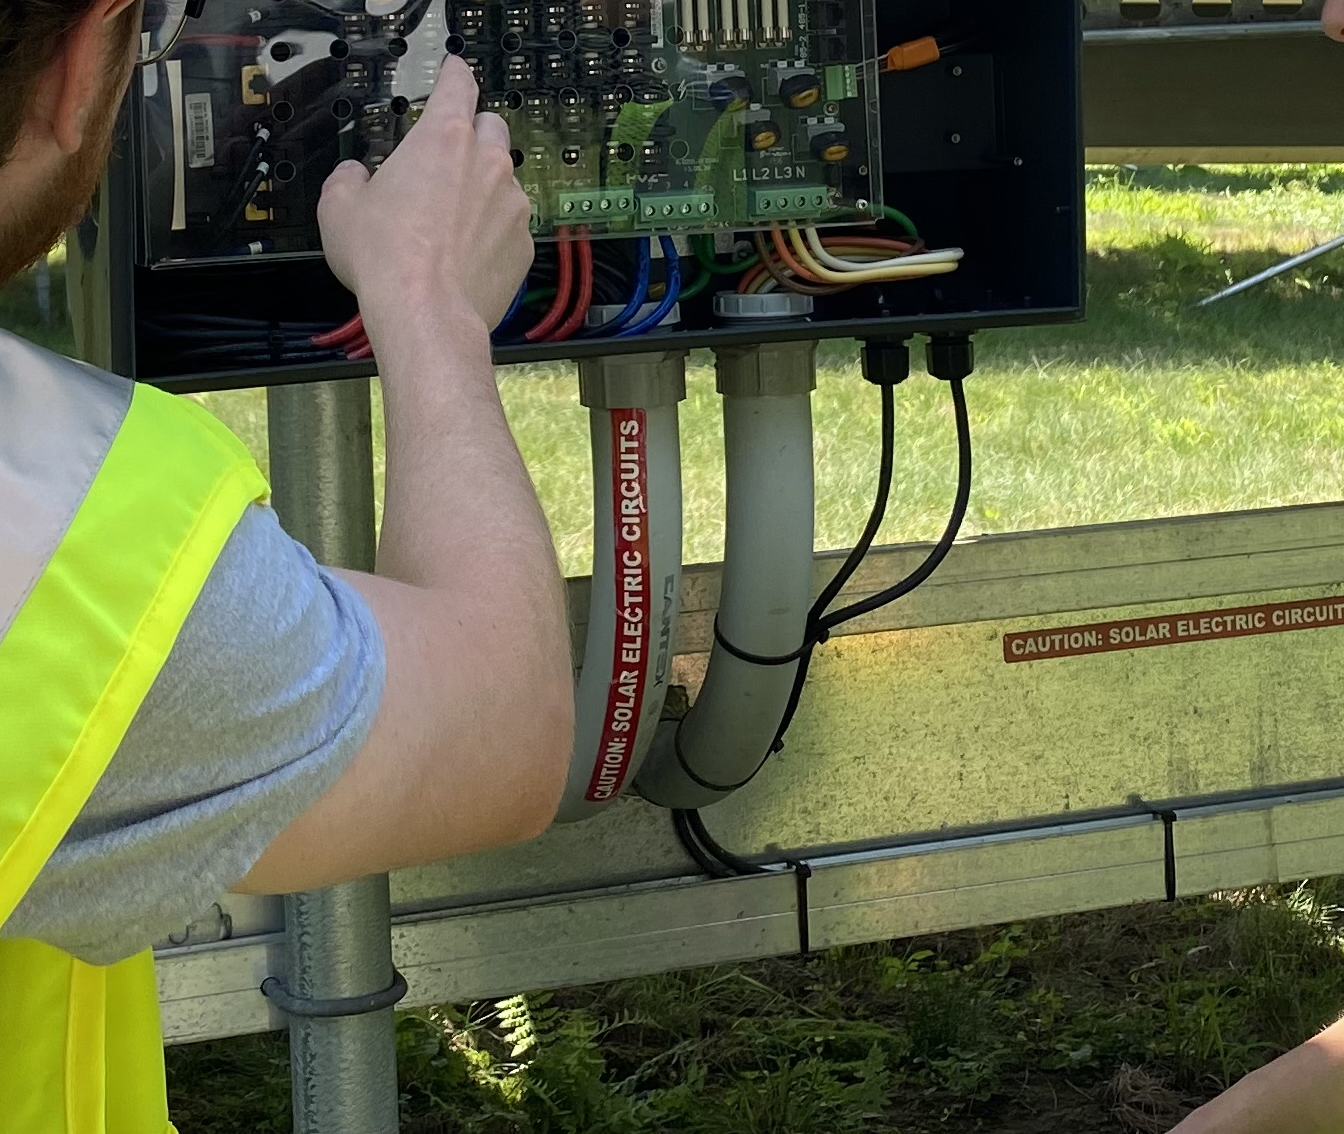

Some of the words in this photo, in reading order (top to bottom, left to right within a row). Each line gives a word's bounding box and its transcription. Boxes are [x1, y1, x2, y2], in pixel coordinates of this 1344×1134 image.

[799, 35, 808, 59] 85-2
[733, 169, 747, 182] L1
[752, 167, 770, 181] L2
[775, 166, 792, 179] L3
[796, 165, 806, 178] N
[619, 420, 642, 542] CIRCUITS
[621, 550, 643, 663] ELECTRIC
[1011, 630, 1103, 656] CAUTION:
[1109, 622, 1172, 645] SOLAR
[1177, 611, 1267, 637] ELECTRIC
[612, 669, 640, 732] SOLAR
[594, 738, 628, 800] CAUTION:
